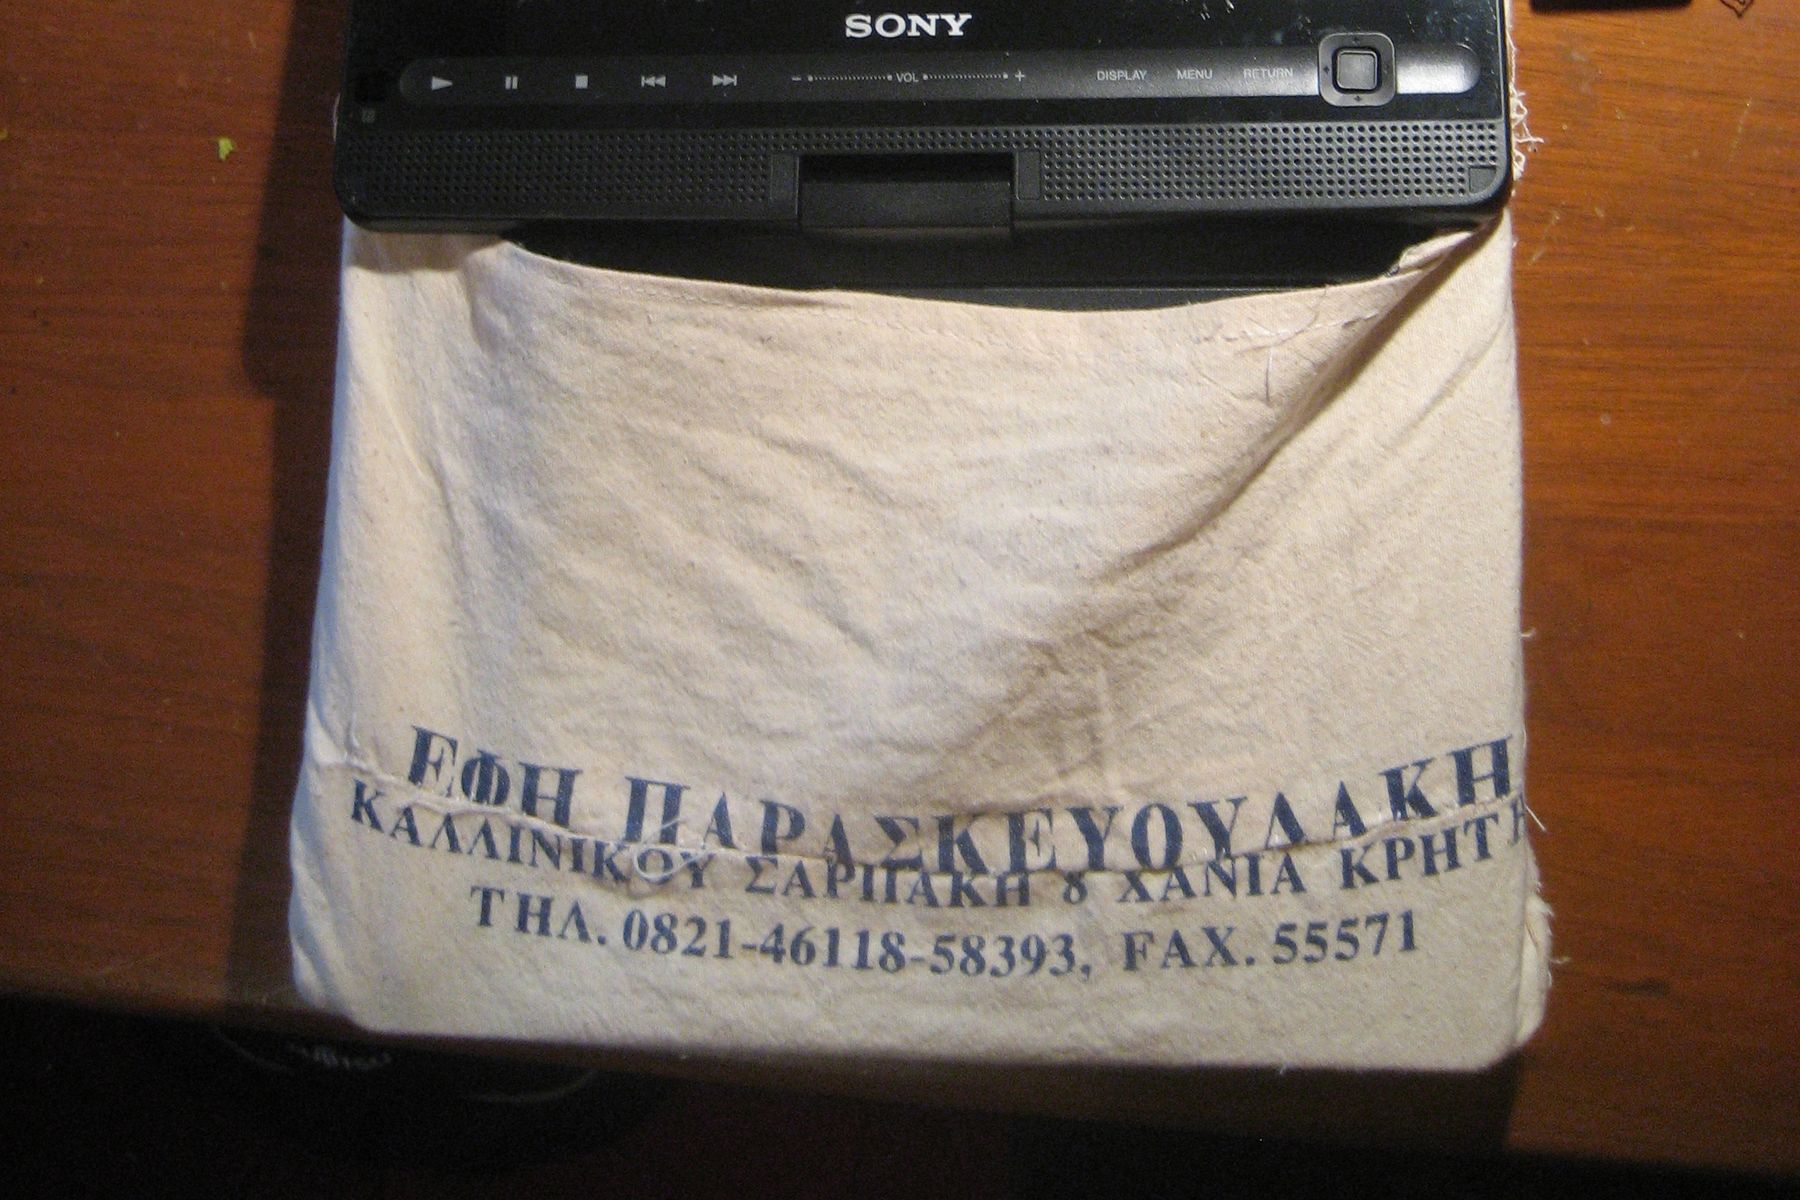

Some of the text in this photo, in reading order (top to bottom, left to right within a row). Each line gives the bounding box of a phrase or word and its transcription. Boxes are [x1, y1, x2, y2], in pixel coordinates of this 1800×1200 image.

[845, 13, 972, 38] SONY
[896, 71, 920, 83] VOL
[1096, 69, 1148, 82] DISPLAY
[1176, 68, 1213, 81] MENU
[1242, 66, 1294, 80] RETURN
[408, 724, 583, 829] ΕΦΗ
[1062, 869, 1088, 905] 8
[1116, 850, 1307, 903] ΧΑΝΙΑ
[1121, 926, 1256, 971] FAX.
[1272, 909, 1417, 965] 55571
